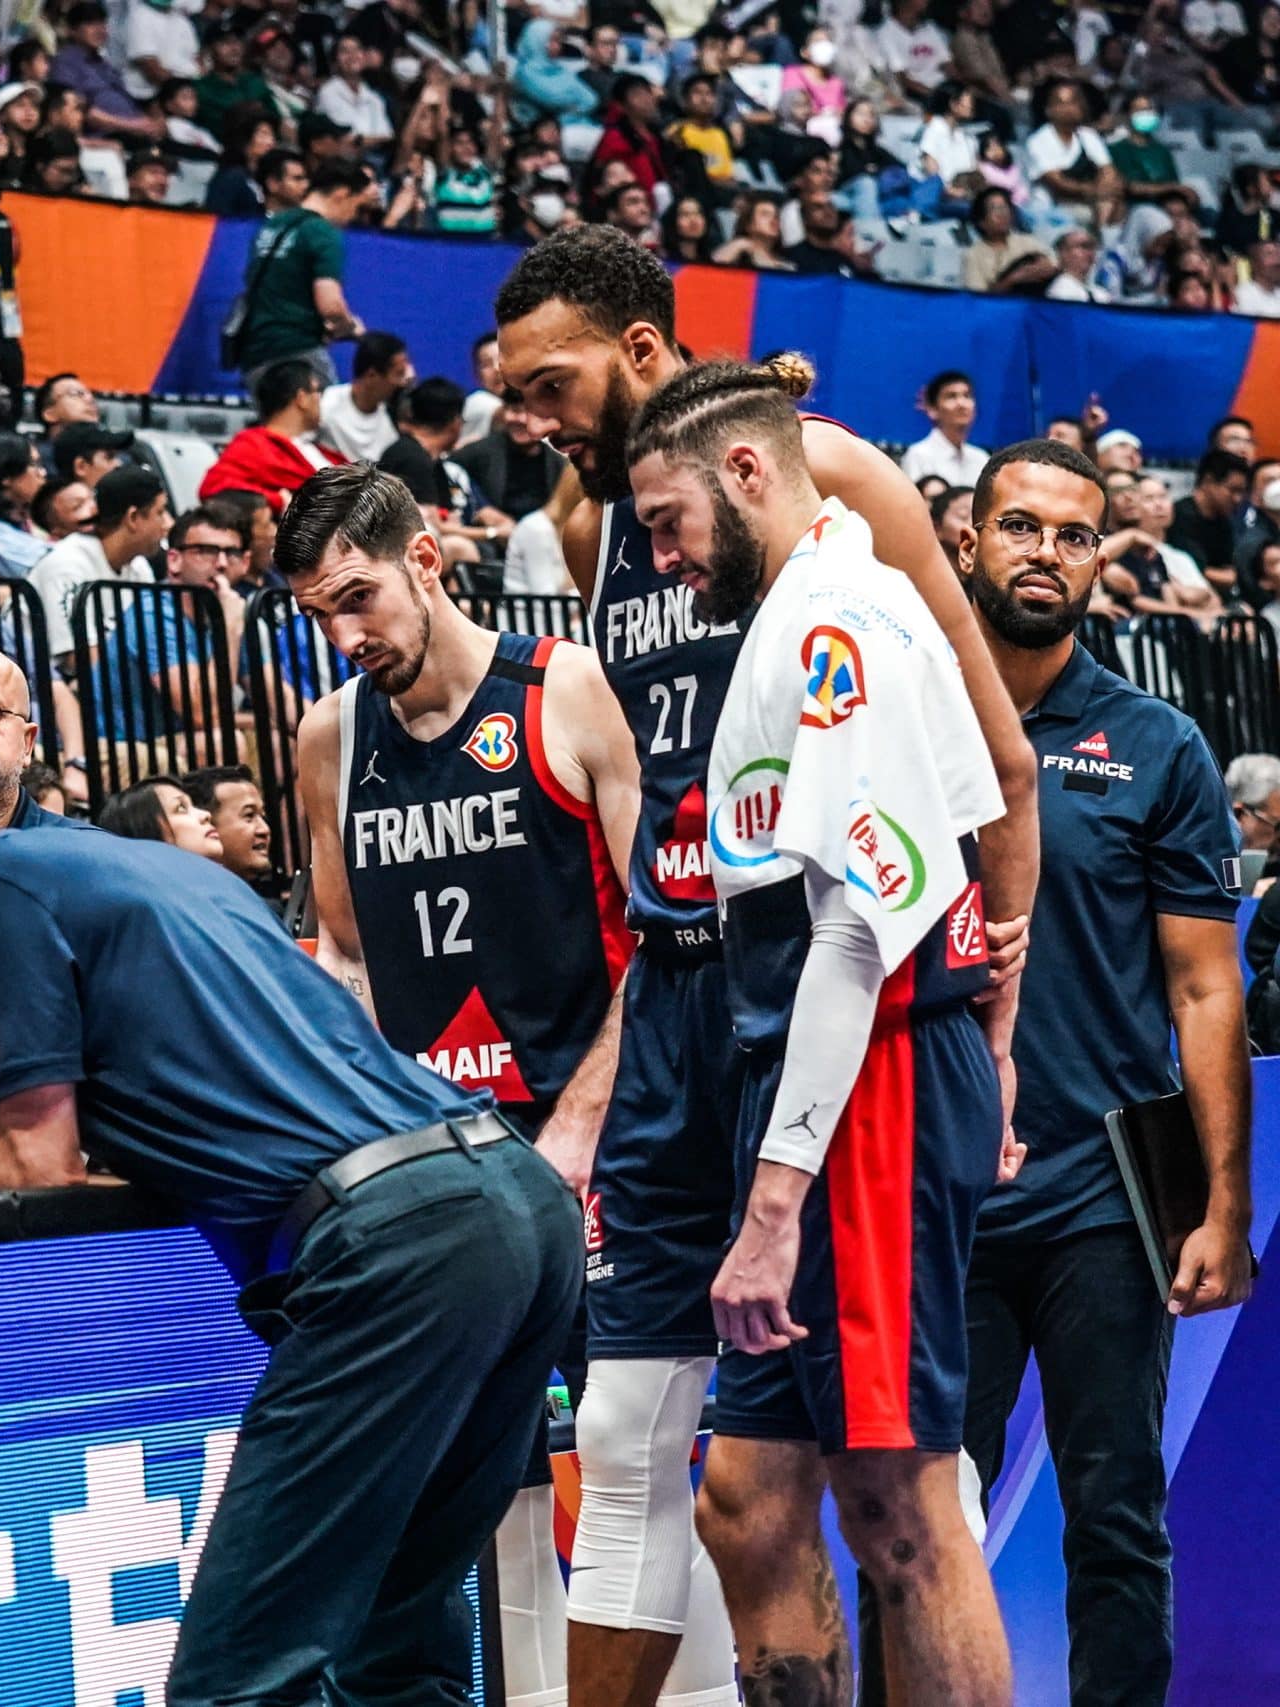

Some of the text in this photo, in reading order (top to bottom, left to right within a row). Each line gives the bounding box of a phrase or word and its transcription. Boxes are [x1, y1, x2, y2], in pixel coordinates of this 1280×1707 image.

[606, 583, 740, 664] FRANC
[649, 674, 699, 755] 27
[1042, 755, 1135, 781] FRANCE
[352, 787, 528, 869] FRANCE
[656, 841, 710, 883] MAI
[413, 886, 473, 957] 12
[674, 927, 712, 946] FRA
[416, 1042, 512, 1082] MAIF
